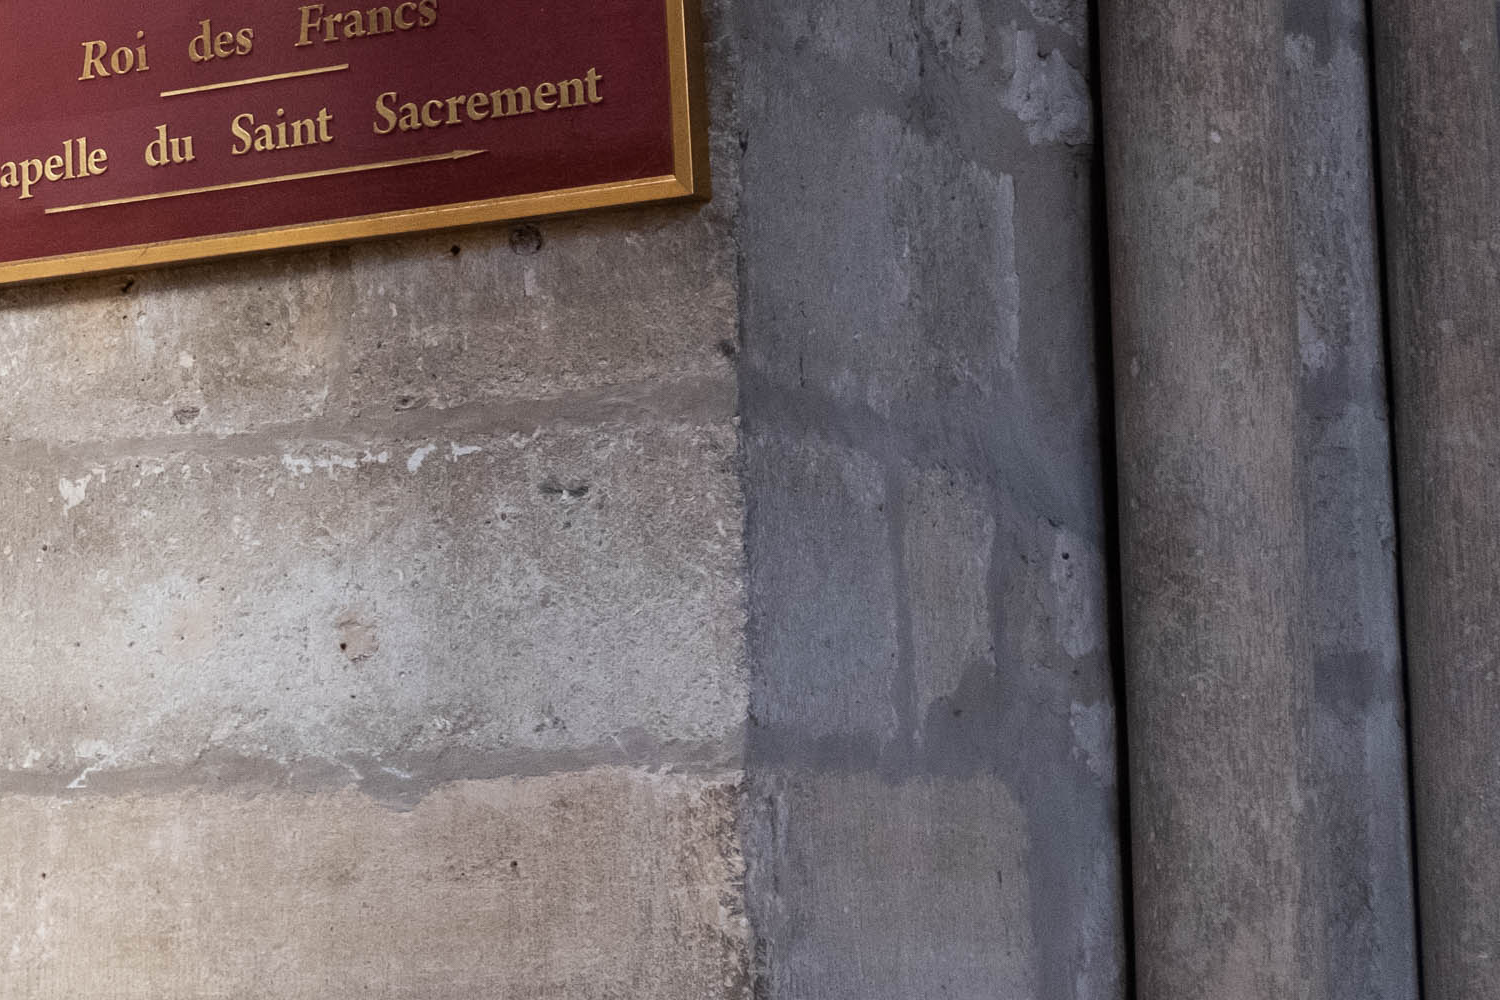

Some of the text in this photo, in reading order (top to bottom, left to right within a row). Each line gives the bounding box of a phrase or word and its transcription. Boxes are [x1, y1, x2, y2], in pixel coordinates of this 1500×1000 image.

[78, 30, 150, 81] Roi
[188, 19, 254, 63] des
[144, 124, 196, 167] du
[231, 107, 334, 156] Saint
[373, 66, 604, 135] Sacrement
